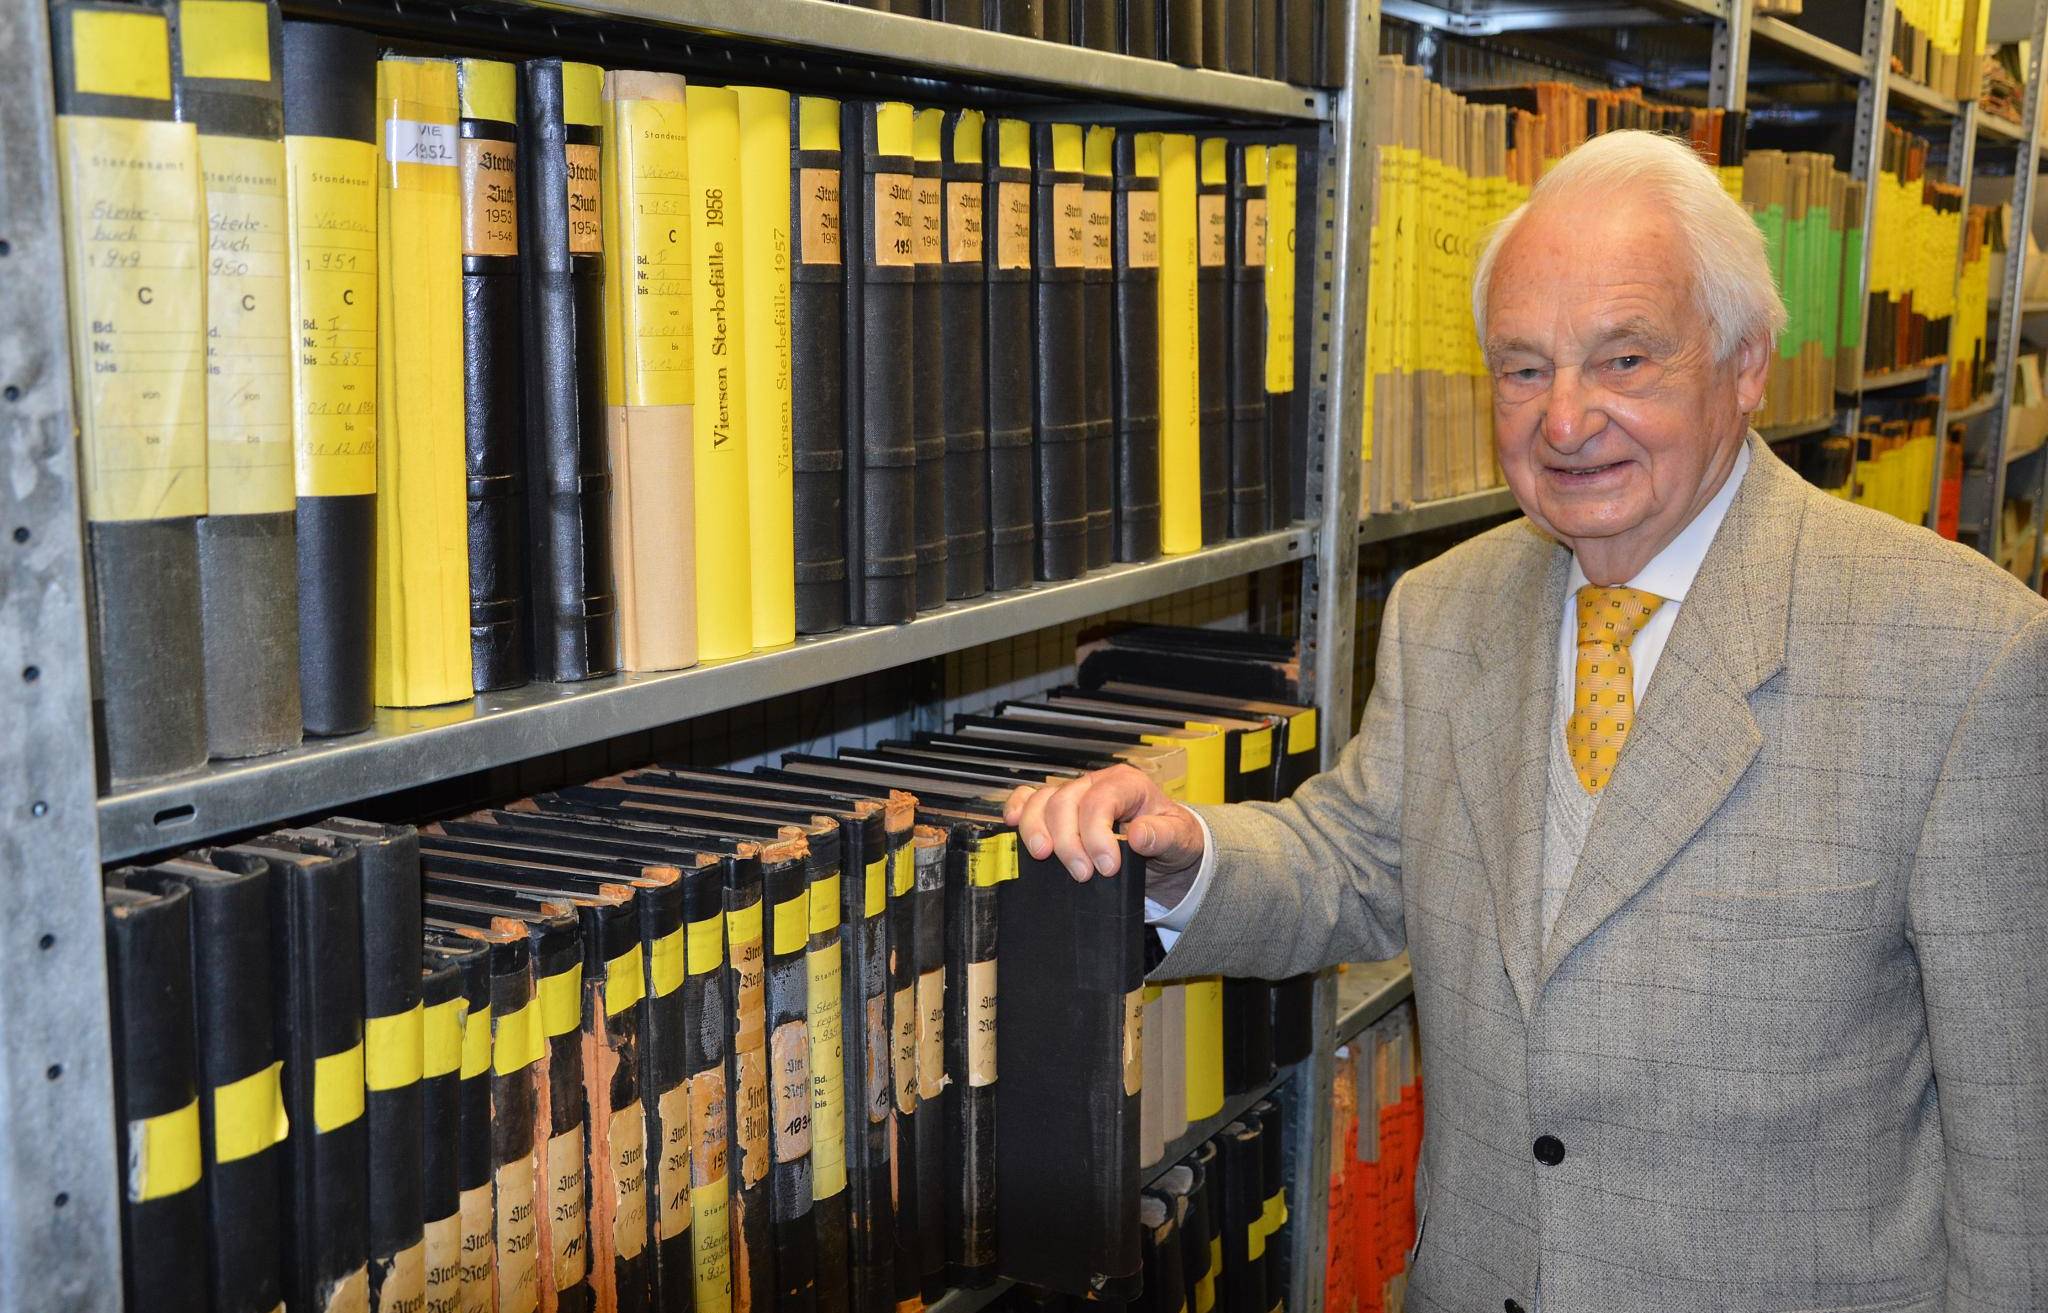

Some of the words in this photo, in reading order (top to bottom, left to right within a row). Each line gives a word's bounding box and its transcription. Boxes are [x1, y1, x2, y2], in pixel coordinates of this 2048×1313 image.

[416, 125, 443, 138] VIE
[406, 143, 453, 160] 1952
[311, 172, 369, 187] Standesamt
[705, 188, 724, 227] 1956
[485, 208, 513, 225] 1953
[571, 221, 598, 236] 1954
[668, 229, 677, 243] C
[773, 228, 786, 273] 1957
[637, 255, 650, 265] Bd.
[637, 271, 649, 280] Nr.
[137, 286, 154, 305] C
[637, 286, 649, 295] bis
[241, 293, 256, 312] C
[342, 289, 354, 306] C
[708, 241, 729, 356] Sterbefälle
[92, 321, 116, 334] Bd.
[303, 319, 319, 331] Bd.
[303, 337, 318, 348] Nr.
[774, 282, 789, 391] Sterbefälle
[93, 341, 113, 353] Nr.
[671, 343, 679, 351] bis
[303, 354, 318, 366] bis
[95, 361, 118, 374] bis
[342, 383, 356, 391] von
[713, 367, 730, 450] Viersen
[344, 421, 355, 432] bis
[146, 435, 160, 445] bis
[776, 402, 790, 476] Viersen
[814, 1074, 828, 1085] Bd.
[814, 1088, 826, 1098] Nr.
[814, 1101, 828, 1110] bis
